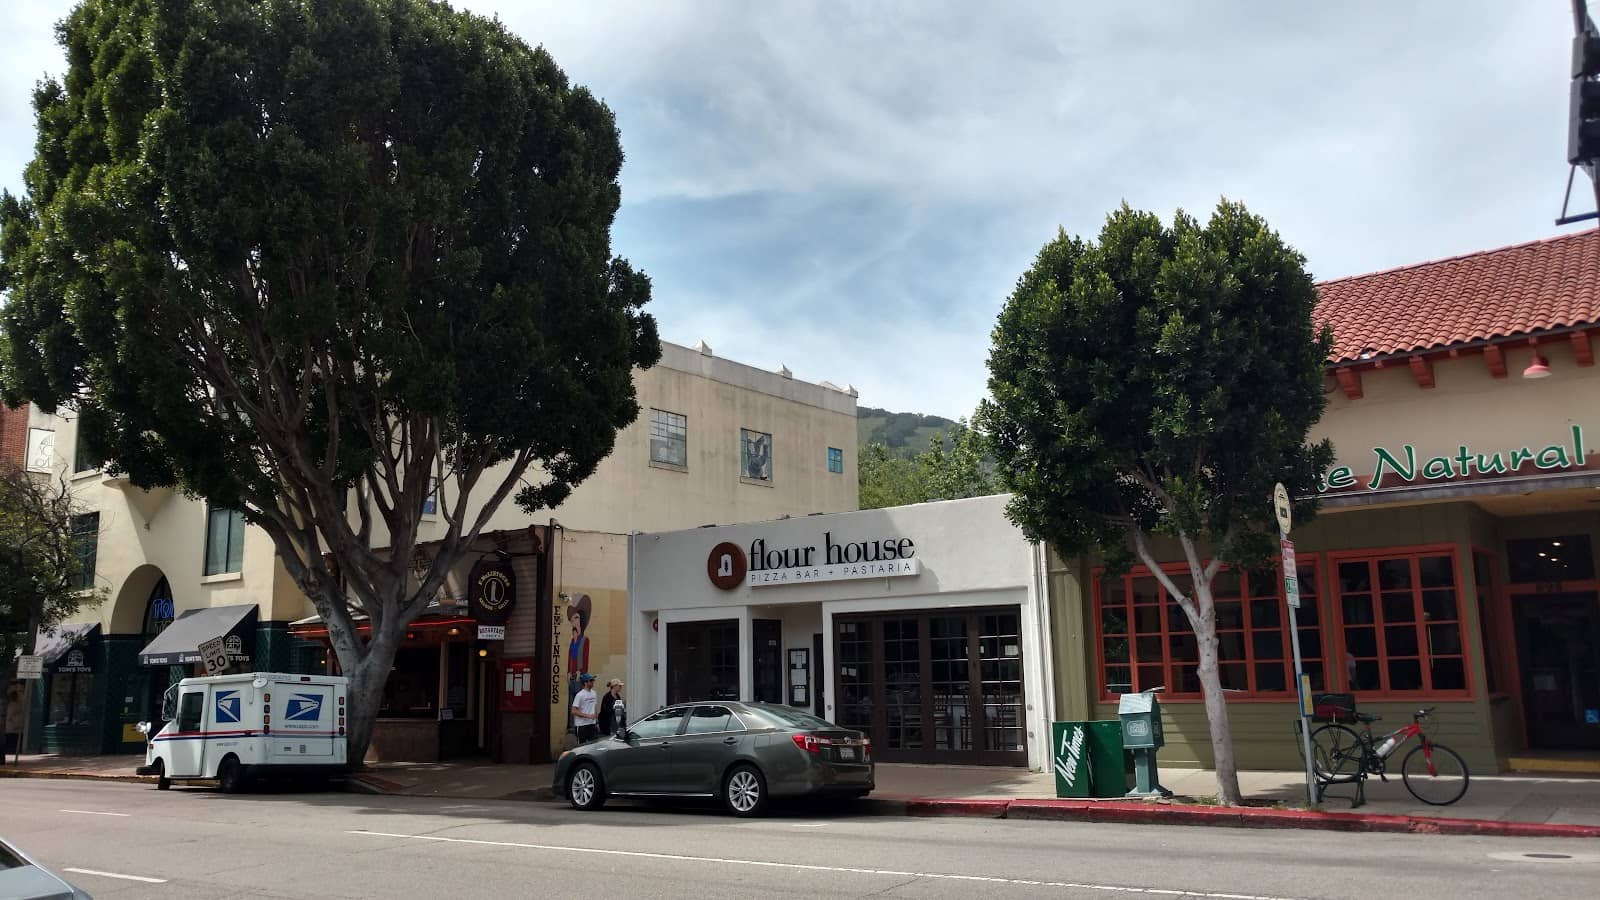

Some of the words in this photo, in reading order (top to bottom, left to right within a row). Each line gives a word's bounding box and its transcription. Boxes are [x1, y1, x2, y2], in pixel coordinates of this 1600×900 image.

[1367, 424, 1586, 490] Natural
[749, 538, 816, 571] flour
[824, 531, 915, 565] house
[751, 573, 788, 583] PIZZA
[795, 569, 820, 580] BAR
[843, 562, 912, 577] PASTARIA
[201, 640, 221, 652] SPEED
[205, 648, 222, 659] LIMIT
[207, 655, 226, 672] 30
[1060, 725, 1085, 760] Times
[1055, 753, 1078, 788] New
